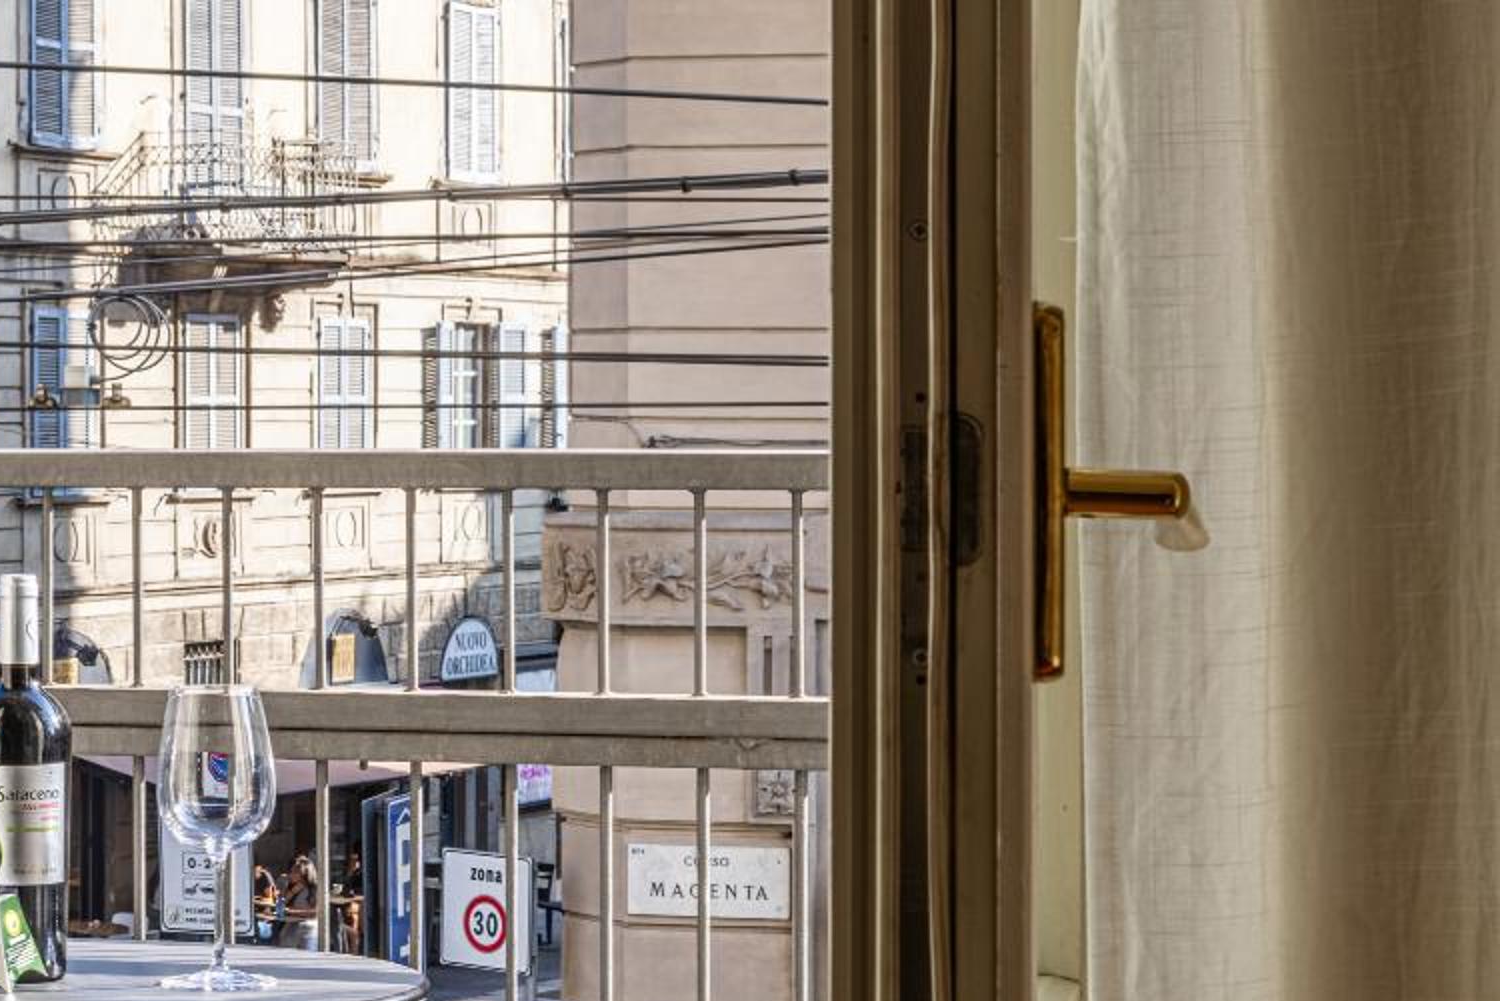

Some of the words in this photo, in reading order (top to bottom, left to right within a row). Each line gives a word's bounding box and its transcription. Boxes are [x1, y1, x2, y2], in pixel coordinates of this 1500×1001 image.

[455, 631, 488, 653] NUOVO
[470, 867, 503, 884] zona
[473, 911, 498, 938] 30
